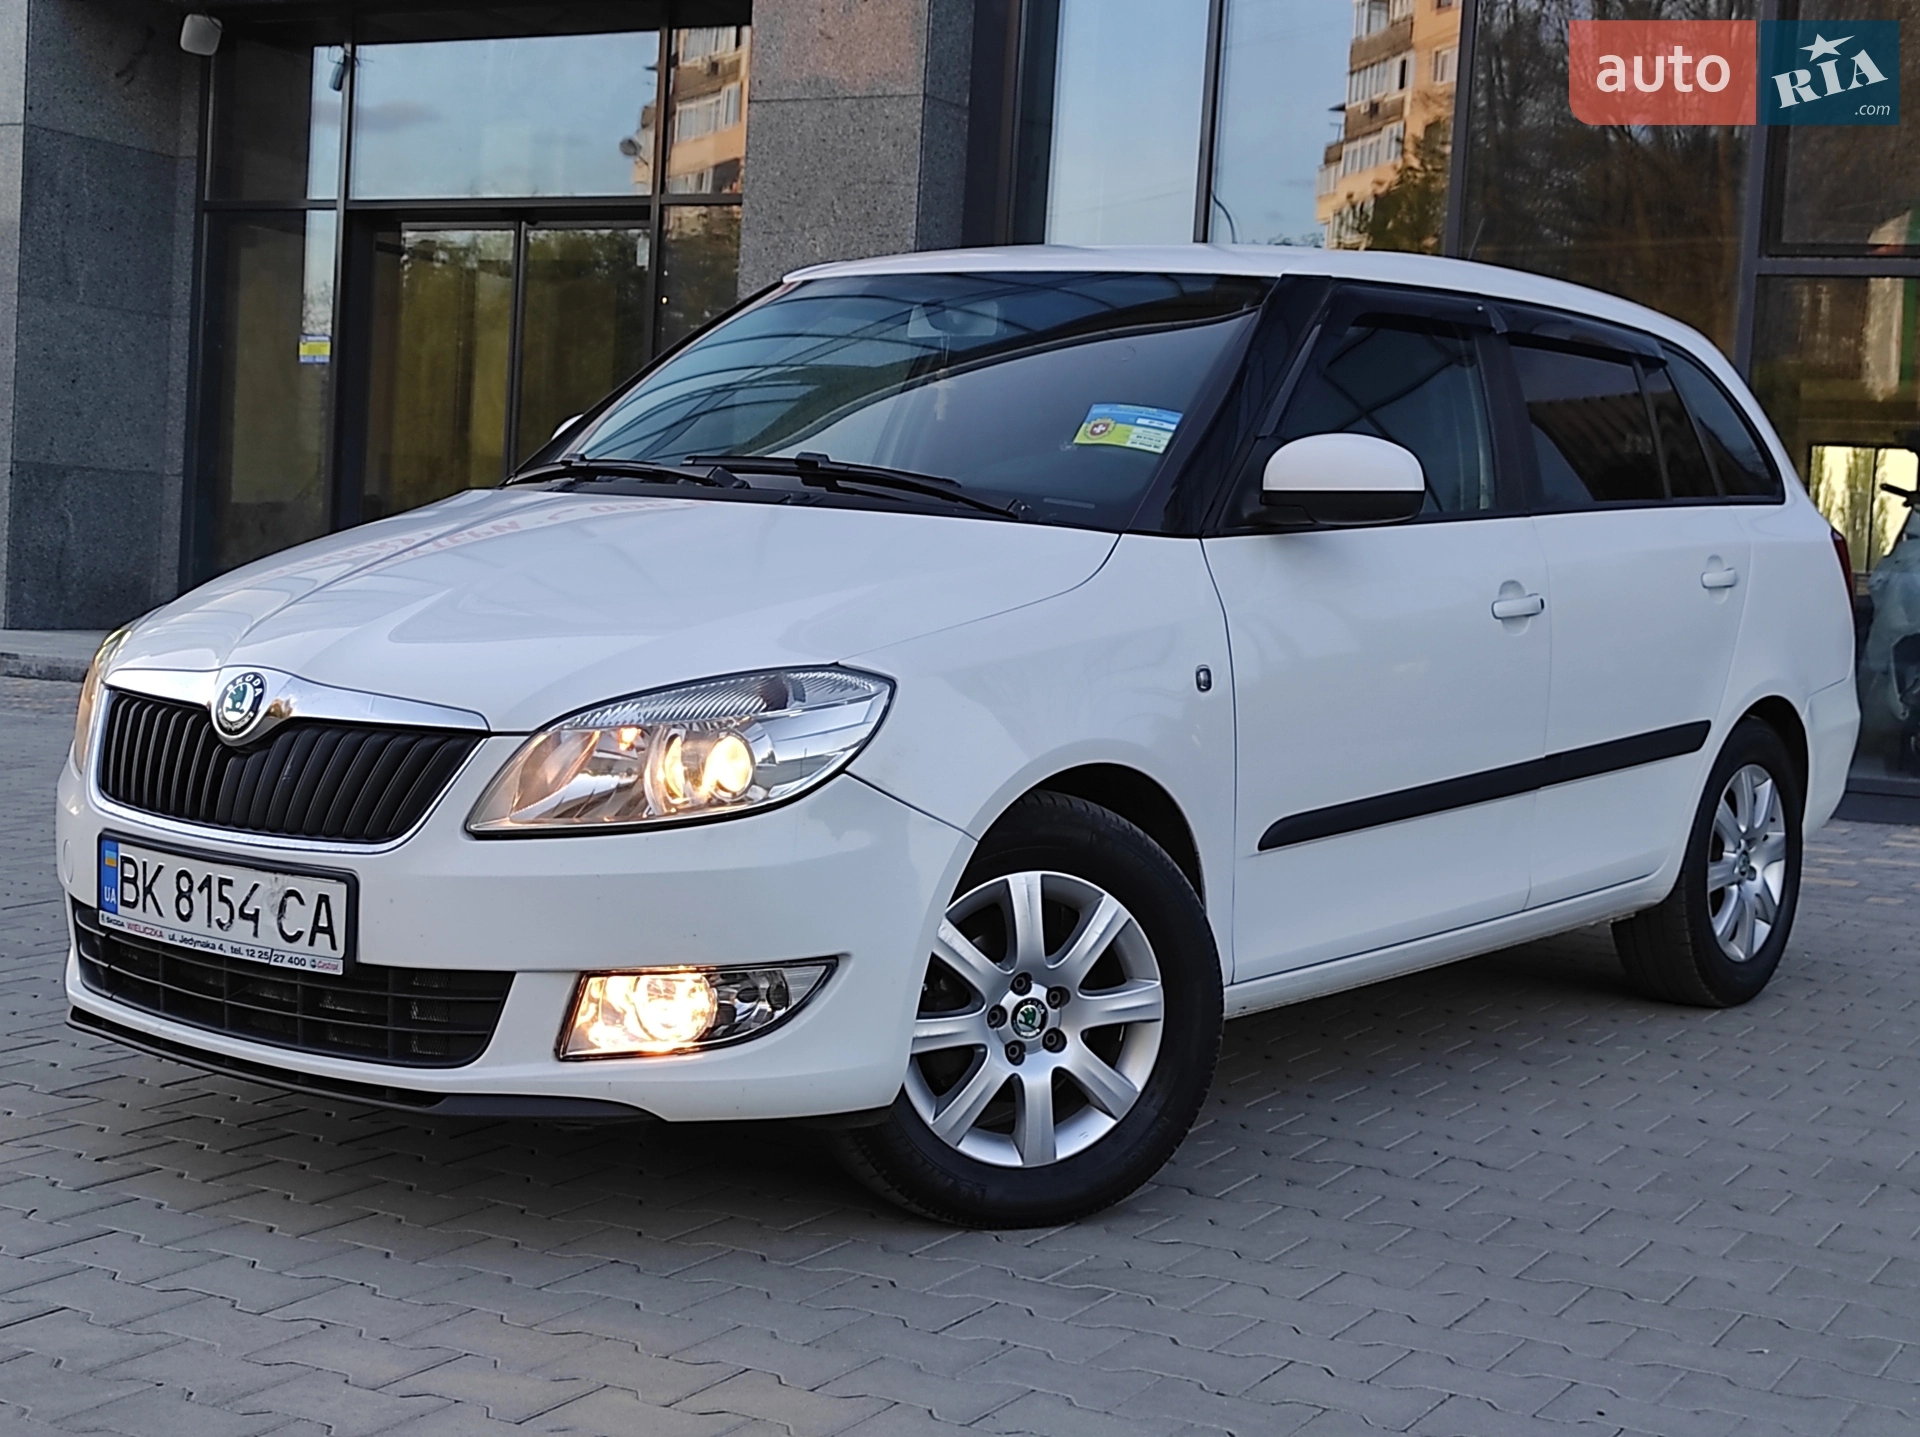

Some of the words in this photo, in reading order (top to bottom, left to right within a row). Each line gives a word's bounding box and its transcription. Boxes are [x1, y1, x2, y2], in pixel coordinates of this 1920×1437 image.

[104, 886, 117, 904] UA
[120, 854, 166, 918] BK
[175, 868, 261, 939] 8154
[277, 888, 338, 951] CA
[127, 921, 164, 938] WIELICZKA
[168, 932, 177, 942] ul.
[230, 945, 243, 956] tel.
[245, 948, 255, 959] 12
[257, 950, 269, 961] 25
[273, 953, 285, 963] 27
[287, 956, 306, 967] 400
